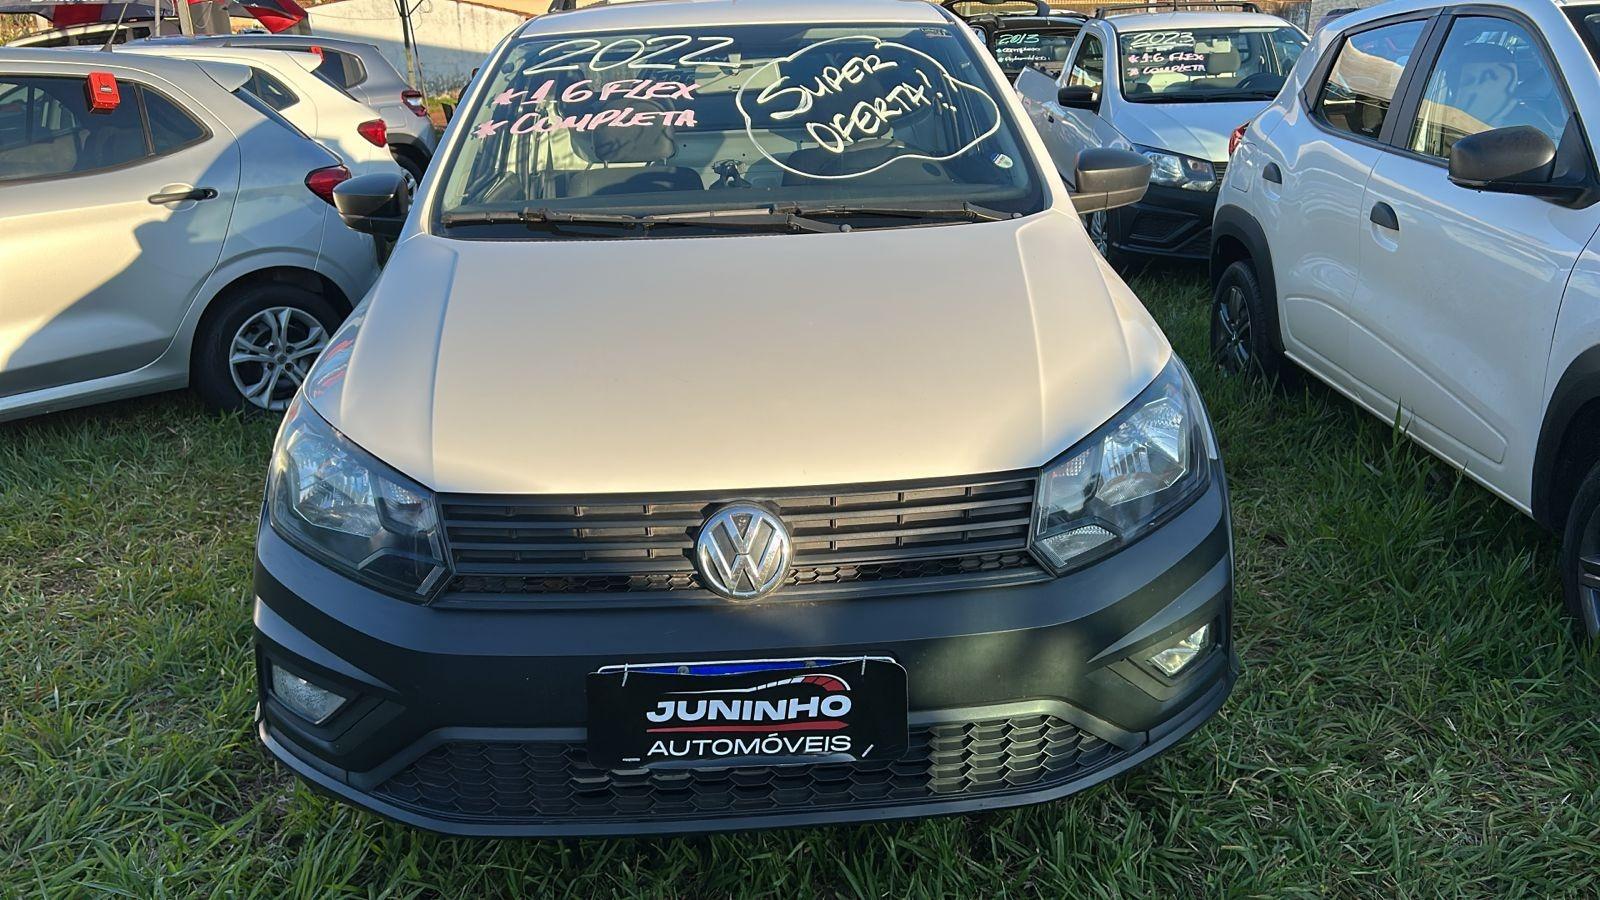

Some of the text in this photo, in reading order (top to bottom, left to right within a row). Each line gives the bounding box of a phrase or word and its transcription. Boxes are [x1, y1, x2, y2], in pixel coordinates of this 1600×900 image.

[999, 33, 1040, 45] 2013
[1130, 32, 1195, 48] 2023
[523, 35, 745, 75] 2022
[599, 79, 701, 101] FLEX
[757, 54, 898, 119] SUPER
[509, 107, 698, 136] COMPLETA
[646, 695, 852, 723] JUNINHO
[647, 733, 852, 757] AUTOMÓVEIS
